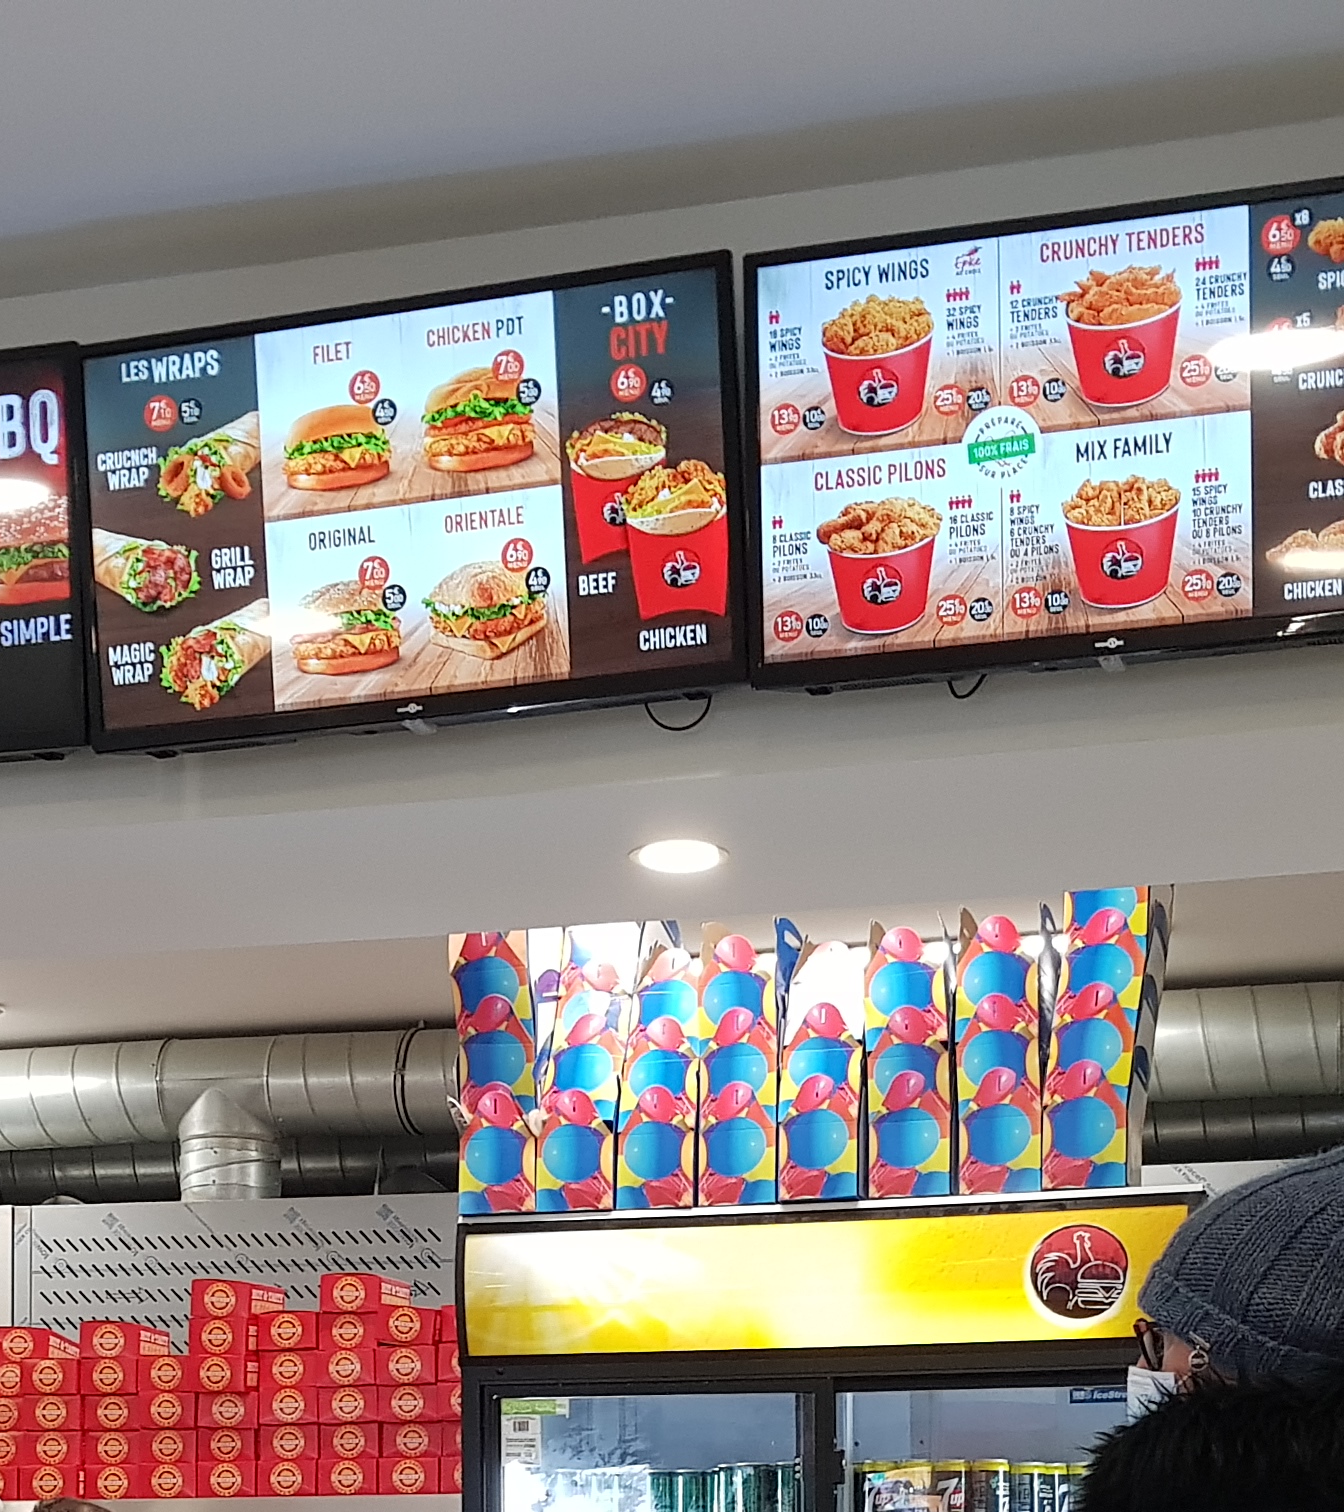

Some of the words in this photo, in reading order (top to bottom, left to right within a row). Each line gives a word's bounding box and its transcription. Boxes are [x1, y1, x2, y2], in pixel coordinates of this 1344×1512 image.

[1040, 234, 1119, 263] CRUNCHY
[1125, 223, 1205, 252] TENDERS
[825, 265, 872, 290] SPICY
[878, 259, 930, 283] WINGS
[1209, 272, 1247, 285] CRUNCHY
[1196, 283, 1245, 301] TENDERS
[1021, 295, 1059, 308] CRUNCHY
[959, 305, 982, 317] SPICY
[1010, 307, 1058, 323] TENDERS
[426, 321, 491, 348] CHICKEN
[496, 316, 524, 338] PDT
[780, 327, 802, 338] SPICY
[946, 316, 979, 332] WINGS
[610, 320, 668, 360] CITY
[769, 338, 801, 353] WINGS
[313, 341, 352, 365] FILET
[121, 360, 149, 383] LES
[151, 349, 220, 383] WRAPS
[973, 444, 998, 458] 100%
[1000, 439, 1029, 454] FRAIS
[1076, 440, 1108, 463] MIX
[1114, 432, 1173, 459] FAMILY
[97, 447, 157, 472] CRUCNCH
[107, 467, 149, 491] WRAP
[815, 464, 883, 492] CLASSIC
[888, 458, 946, 485] PILONS
[1204, 484, 1228, 495] SPICY
[1017, 505, 1040, 515] SPICY
[1192, 496, 1218, 506] WINGS
[1204, 504, 1243, 516] CRUNCHY
[445, 506, 524, 533] ORIENTALE
[960, 511, 993, 524] CLASSIC
[1010, 514, 1035, 525] WINGS
[1192, 516, 1229, 528] TENDERS
[309, 525, 375, 551] ORIGINAL
[779, 531, 812, 543] CLASSIC
[949, 524, 986, 539] PILONS
[1017, 524, 1054, 536] CRUNCHY
[1192, 529, 1203, 539] OU
[1213, 526, 1243, 538] PILONS
[1010, 535, 1046, 547] TENDERS
[1031, 544, 1060, 555] PILONS
[211, 546, 254, 569] GRILL
[773, 543, 808, 558] PILONS
[212, 566, 255, 590] WRAP
[578, 572, 616, 596] BEEF
[1284, 577, 1343, 600] CHICKEN
[0, 614, 72, 646] SIMPLE
[639, 624, 707, 651] CHICKEN
[108, 642, 155, 666] MAGIC
[112, 663, 153, 685] WRAP
